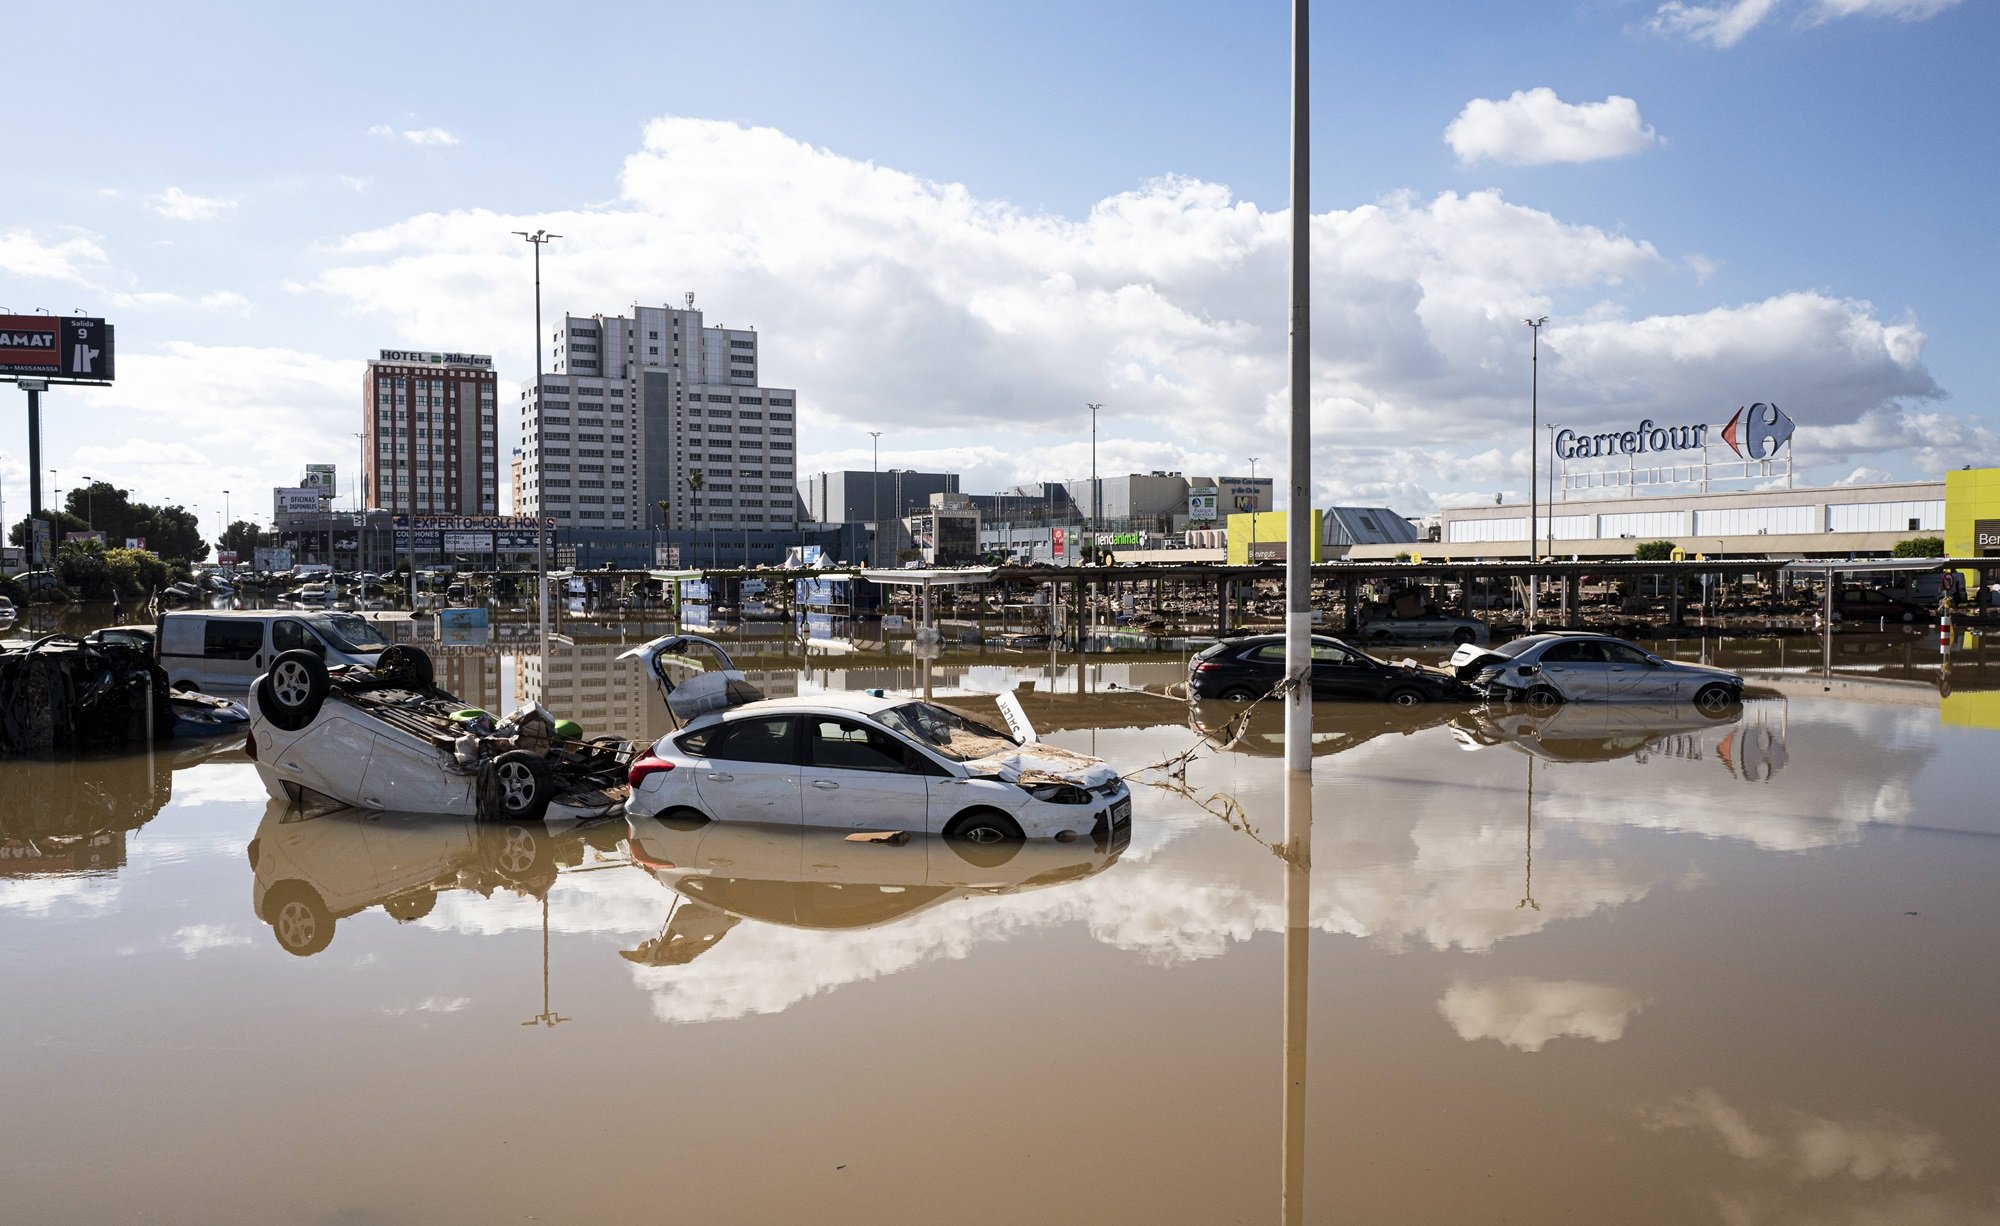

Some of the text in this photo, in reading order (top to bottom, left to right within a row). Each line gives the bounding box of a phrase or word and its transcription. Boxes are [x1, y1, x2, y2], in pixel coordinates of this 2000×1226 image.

[77, 328, 88, 339] 9
[381, 350, 492, 366] HOTEL Albufera
[1556, 419, 1708, 460] Carrefour
[1221, 477, 1241, 485] Centro
[413, 517, 473, 529] EXPERTO
